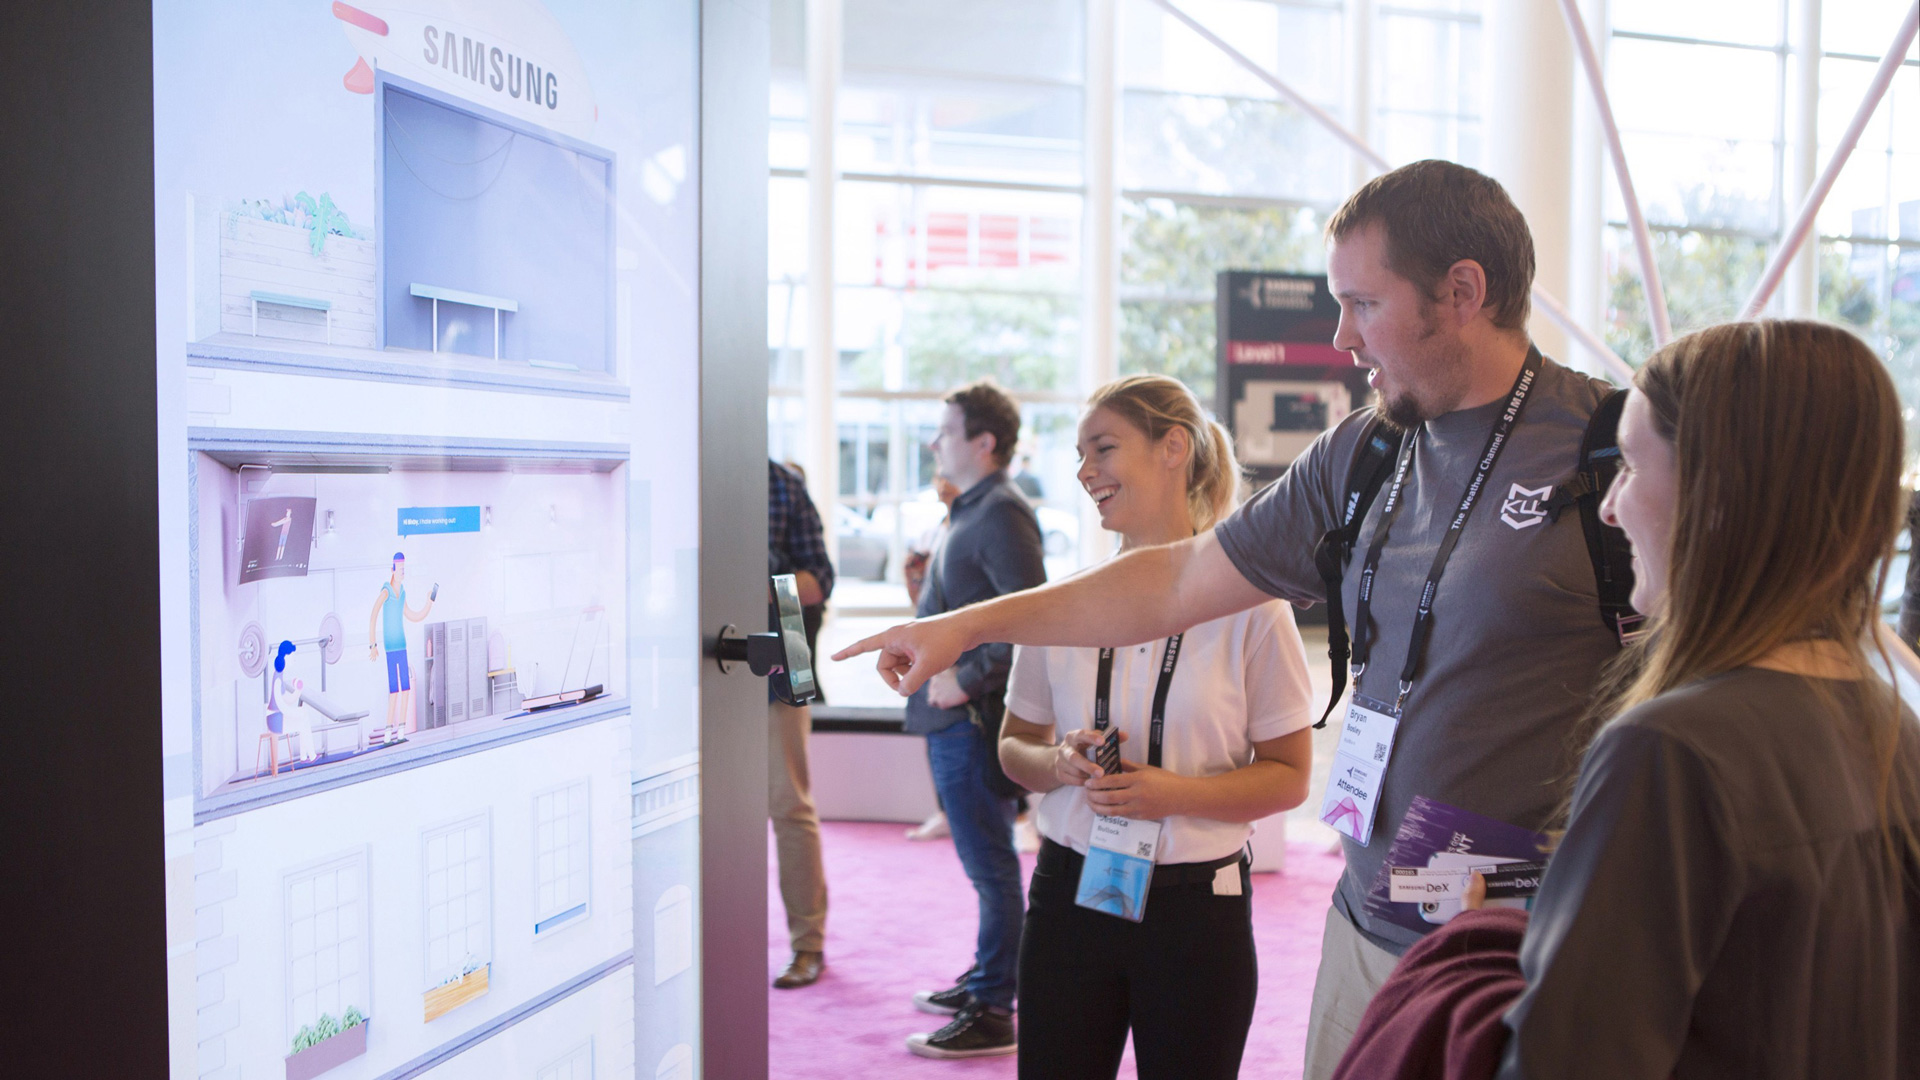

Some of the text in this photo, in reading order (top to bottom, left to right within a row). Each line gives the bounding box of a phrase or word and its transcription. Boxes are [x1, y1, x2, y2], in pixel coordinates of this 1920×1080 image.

[423, 25, 557, 110] SAMSUNG
[1235, 344, 1276, 364] Level
[1451, 512, 1466, 530] The
[1460, 472, 1485, 511] Weather
[1480, 433, 1504, 471] Channel
[1503, 369, 1535, 422] SAMSUNG
[1384, 459, 1408, 513] SAMSUNG
[1164, 634, 1179, 673] AMSUNG
[1350, 709, 1367, 723] Bryan
[1337, 778, 1368, 801] Attendee
[1427, 882, 1449, 893] DeX
[1515, 877, 1540, 889] DeX
